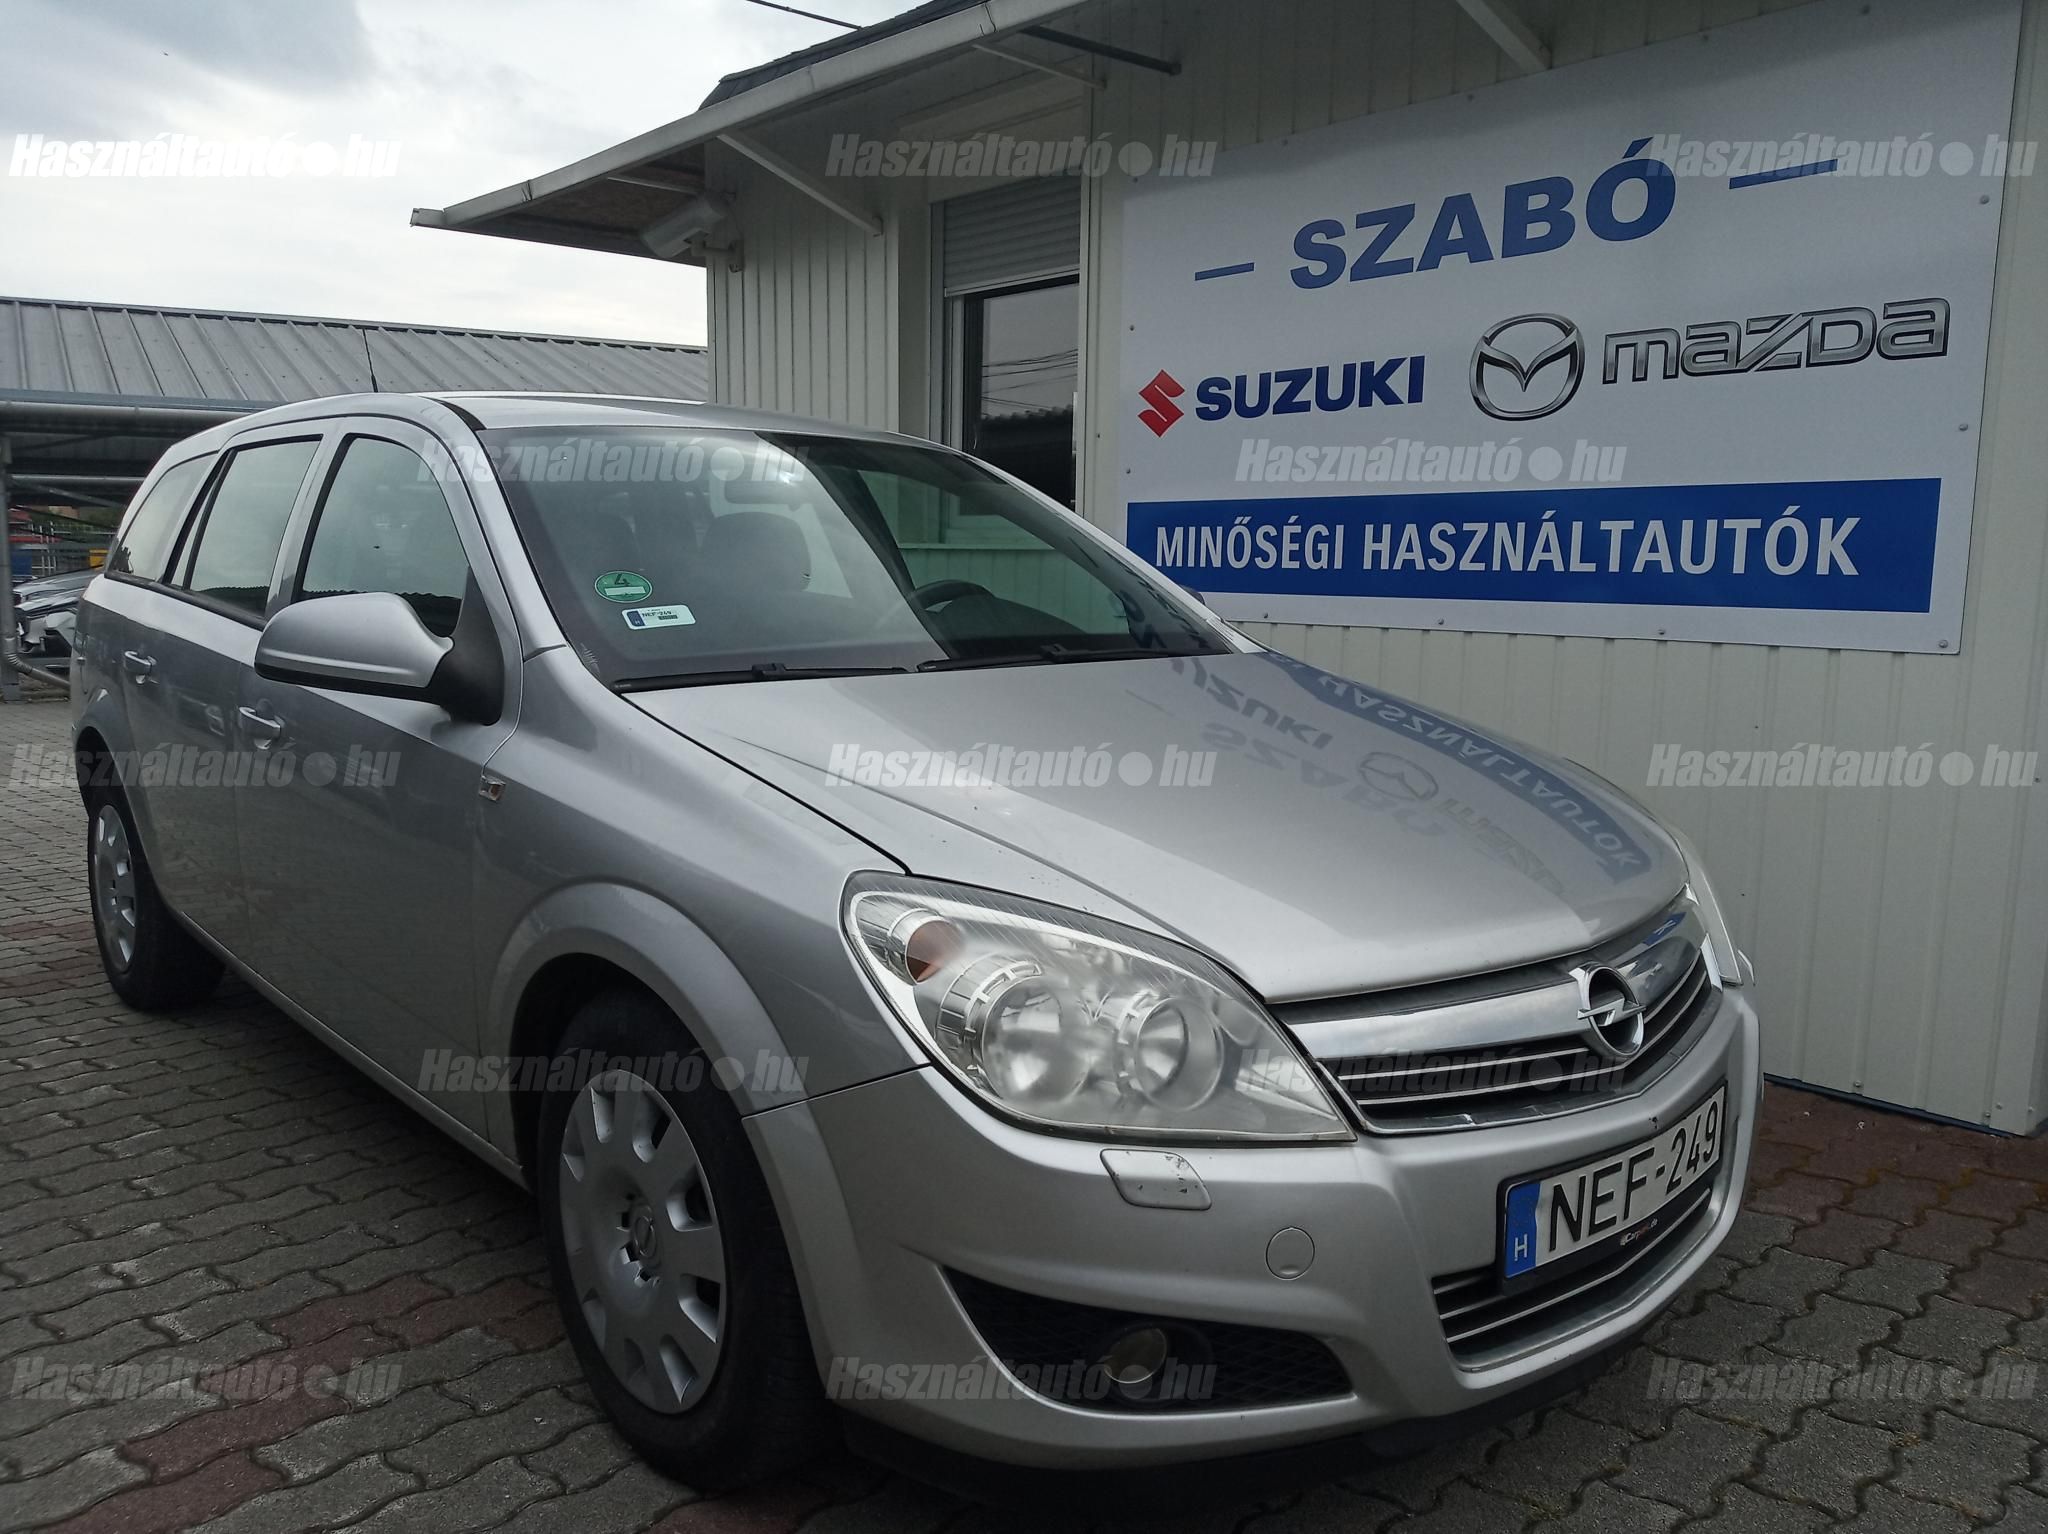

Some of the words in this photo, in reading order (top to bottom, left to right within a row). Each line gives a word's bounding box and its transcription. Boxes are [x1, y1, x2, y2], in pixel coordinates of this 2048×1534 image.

[1290, 137, 1677, 289] SZABÓ
[1196, 355, 1425, 421] SUZUKI
[1156, 512, 1344, 571] MINŐSÉGI
[1364, 505, 1861, 577] HASZNÁLTAUTÓK
[1514, 1233, 1528, 1261] H
[1548, 1100, 1719, 1253] NEF-249
